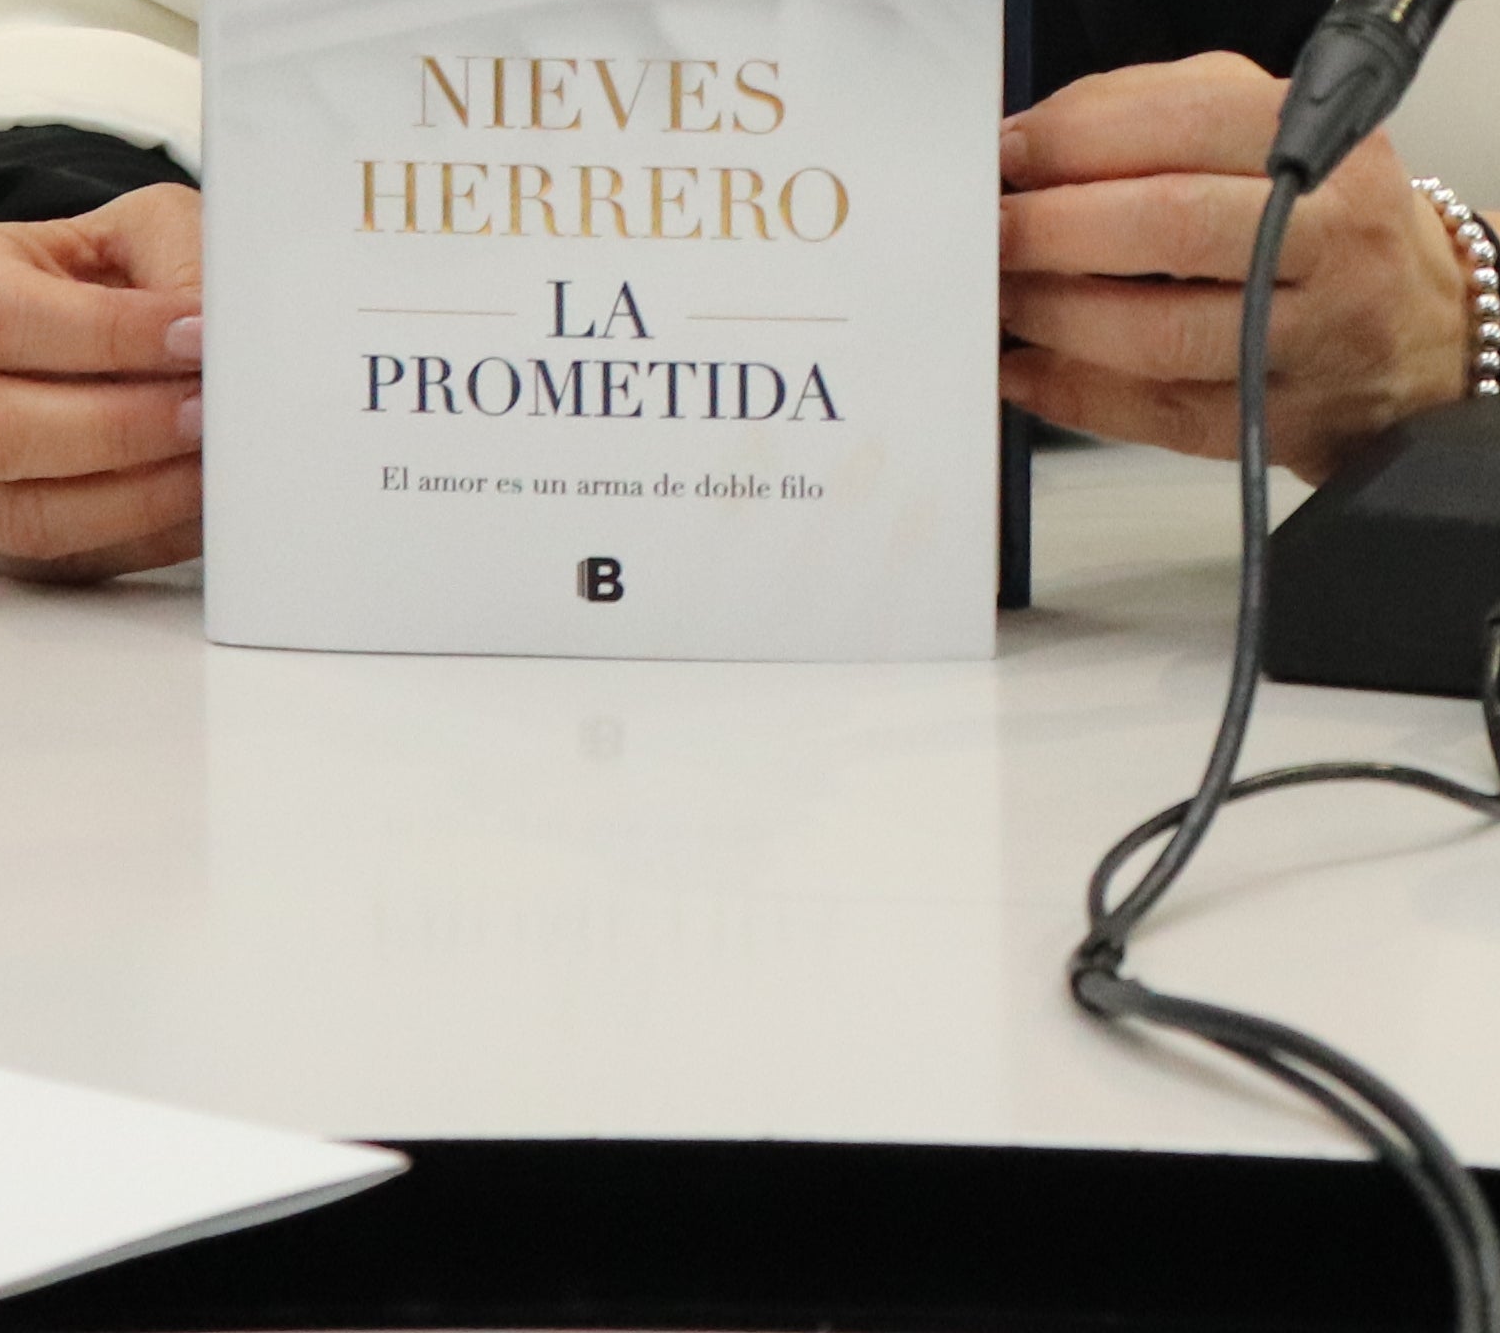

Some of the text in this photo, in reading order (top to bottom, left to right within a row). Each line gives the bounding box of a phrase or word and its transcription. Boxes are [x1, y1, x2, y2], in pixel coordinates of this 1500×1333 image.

[412, 54, 786, 135] NIEVES
[354, 159, 849, 243] HERRERO
[546, 280, 656, 339] LA
[361, 353, 845, 422] PROMETIDA
[381, 466, 824, 501] El amor es un arma de doble filo
[578, 556, 625, 603] B
